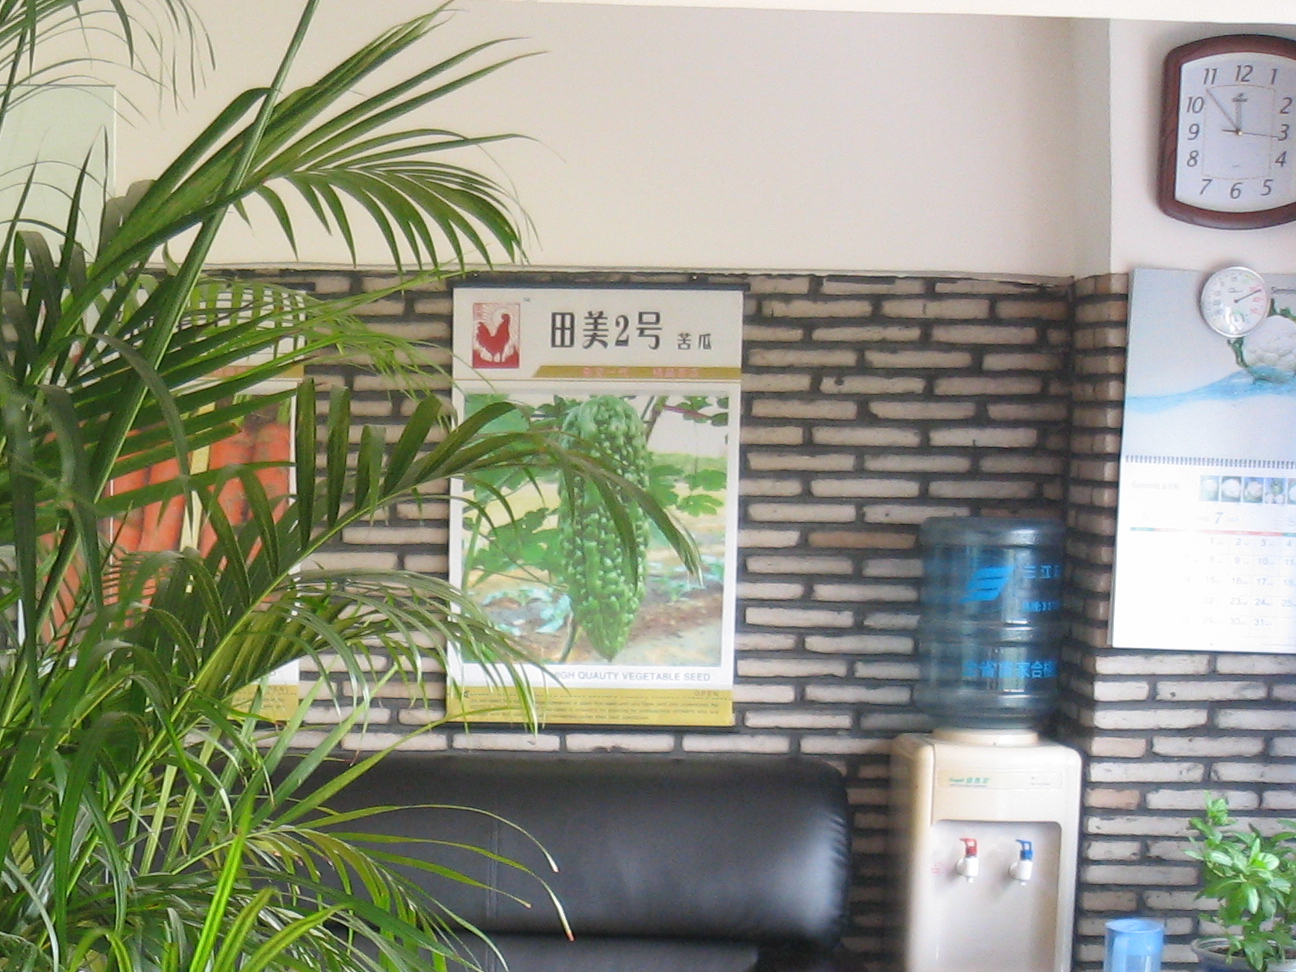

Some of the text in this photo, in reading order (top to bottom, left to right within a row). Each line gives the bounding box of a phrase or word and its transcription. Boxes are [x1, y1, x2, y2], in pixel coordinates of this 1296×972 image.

[1203, 68, 1218, 85] 11
[1235, 65, 1253, 82] 12
[1270, 68, 1278, 84] 1
[1186, 96, 1204, 114] 10
[1280, 97, 1293, 114] 2
[1187, 123, 1200, 140] 9
[1277, 124, 1290, 141] 3
[1186, 151, 1199, 167] 8
[1275, 151, 1287, 167] 4
[1199, 179, 1212, 195] 7
[1230, 182, 1243, 199] 6
[1261, 179, 1274, 196] 5
[550, 310, 712, 350] 田美2号 苦瓜
[622, 671, 681, 681] VEGETABLE
[683, 672, 711, 682] SEED
